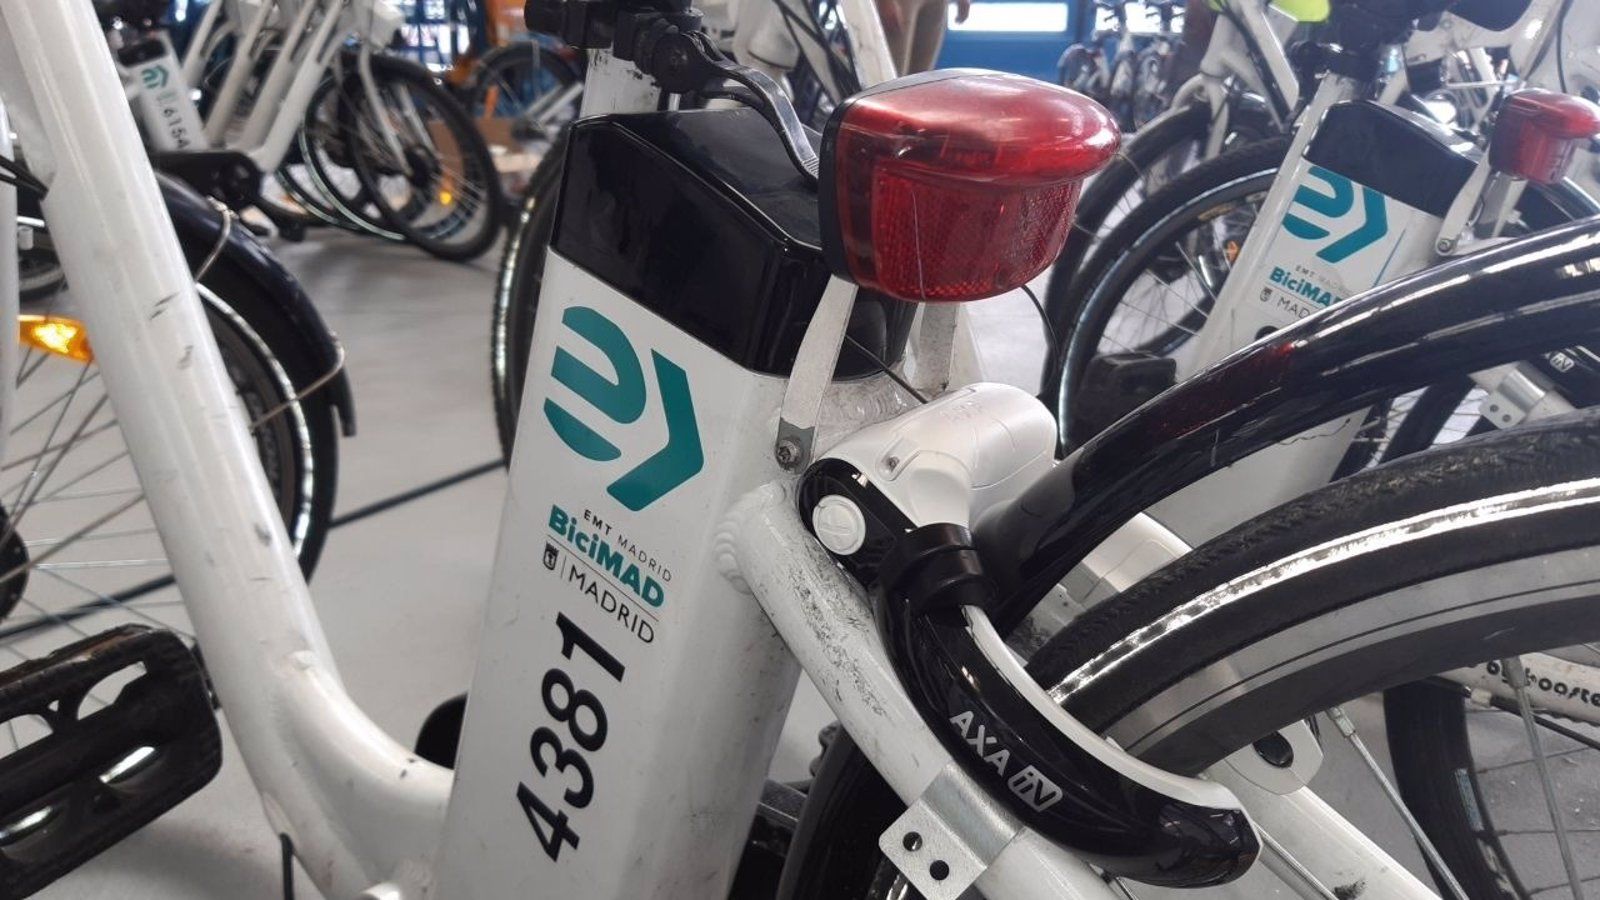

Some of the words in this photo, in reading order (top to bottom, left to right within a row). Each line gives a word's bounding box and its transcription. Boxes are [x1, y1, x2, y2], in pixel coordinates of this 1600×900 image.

[1277, 297, 1311, 319] MAD
[548, 504, 665, 608] BiciMAD
[583, 509, 612, 534] EMT
[617, 535, 672, 582] MADRID
[569, 564, 654, 643] MADRID
[516, 611, 626, 862] 4381
[950, 710, 1010, 777] AXA
